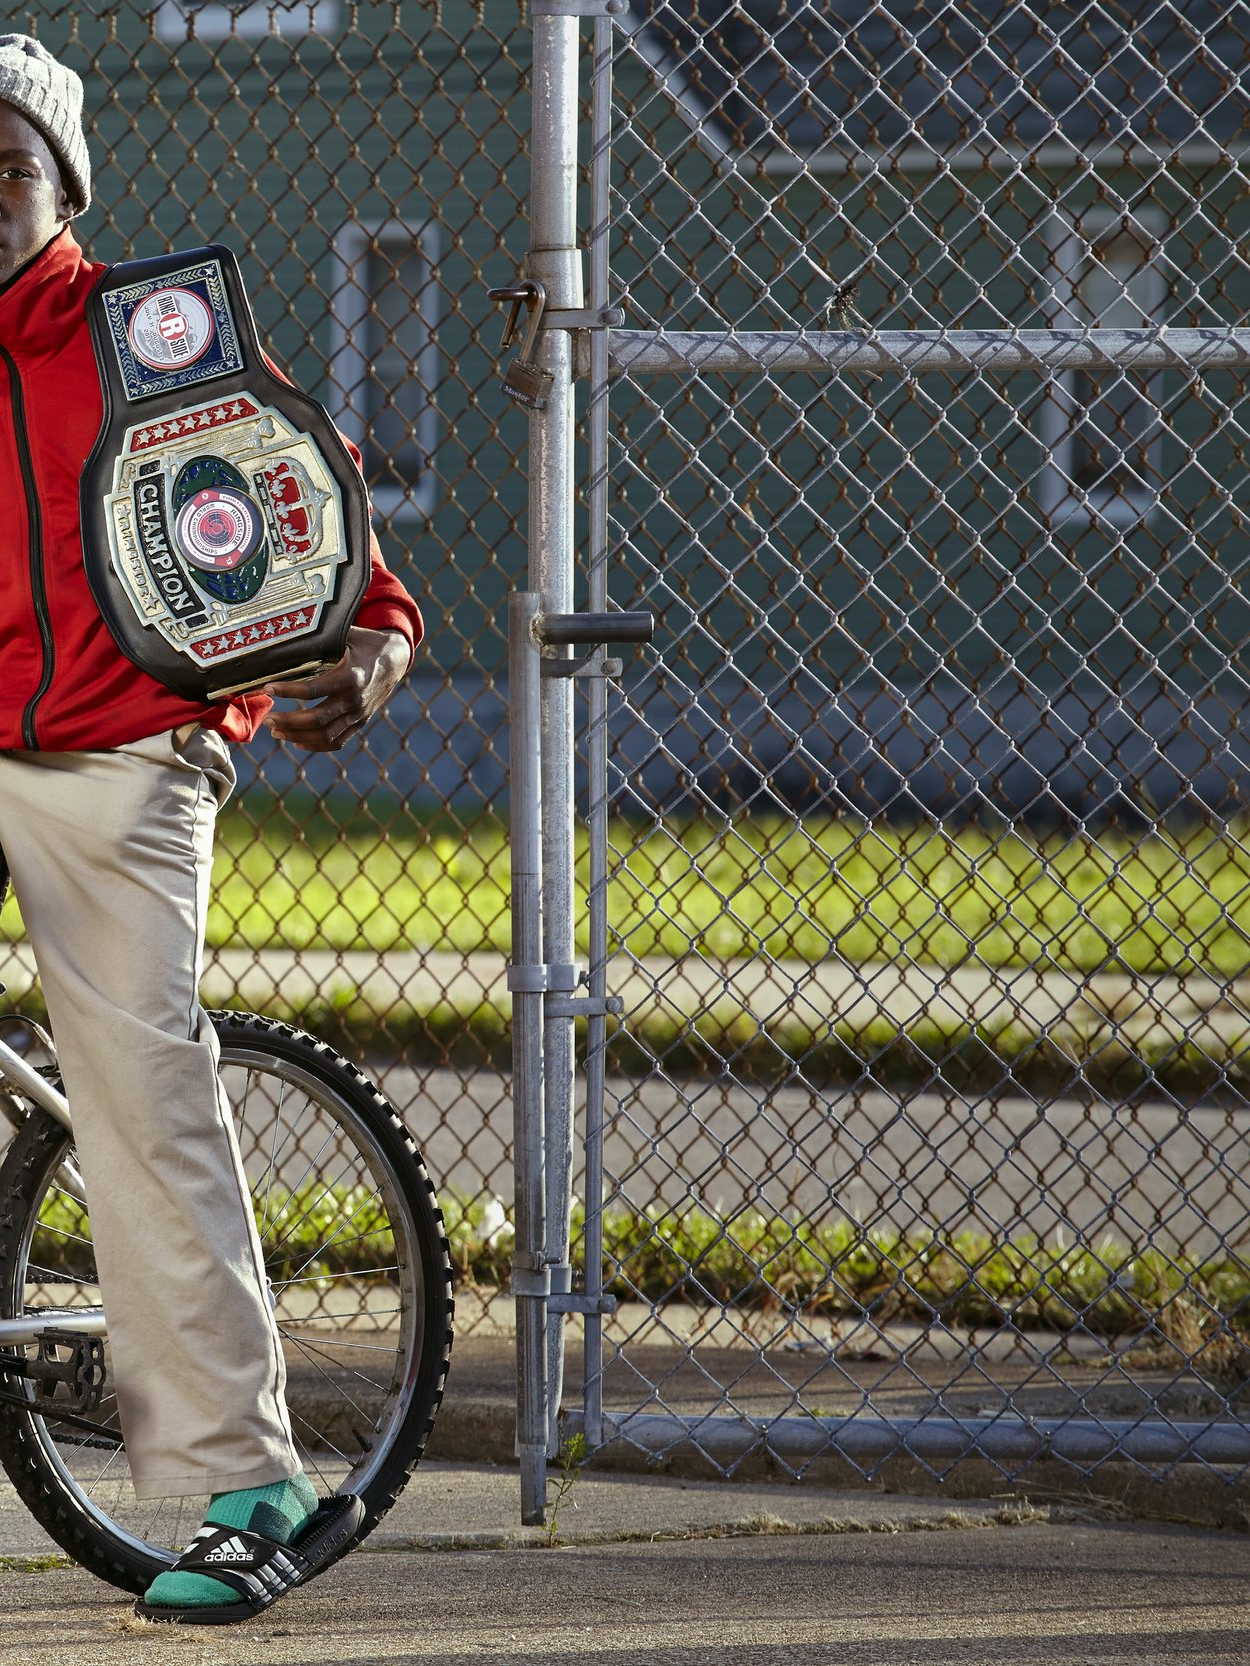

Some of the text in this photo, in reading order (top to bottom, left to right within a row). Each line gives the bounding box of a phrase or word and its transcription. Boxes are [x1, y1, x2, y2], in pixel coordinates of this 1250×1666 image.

[157, 296, 176, 315] RING
[170, 338, 188, 358] SIDE
[504, 385, 530, 402] Master
[191, 517, 218, 555] CHAMPIONSHIPS
[230, 508, 244, 546] RINGSIDE
[118, 518, 150, 598] RINGSIDE
[140, 484, 195, 611] CHAMPION
[204, 1551, 254, 1562] adidas
